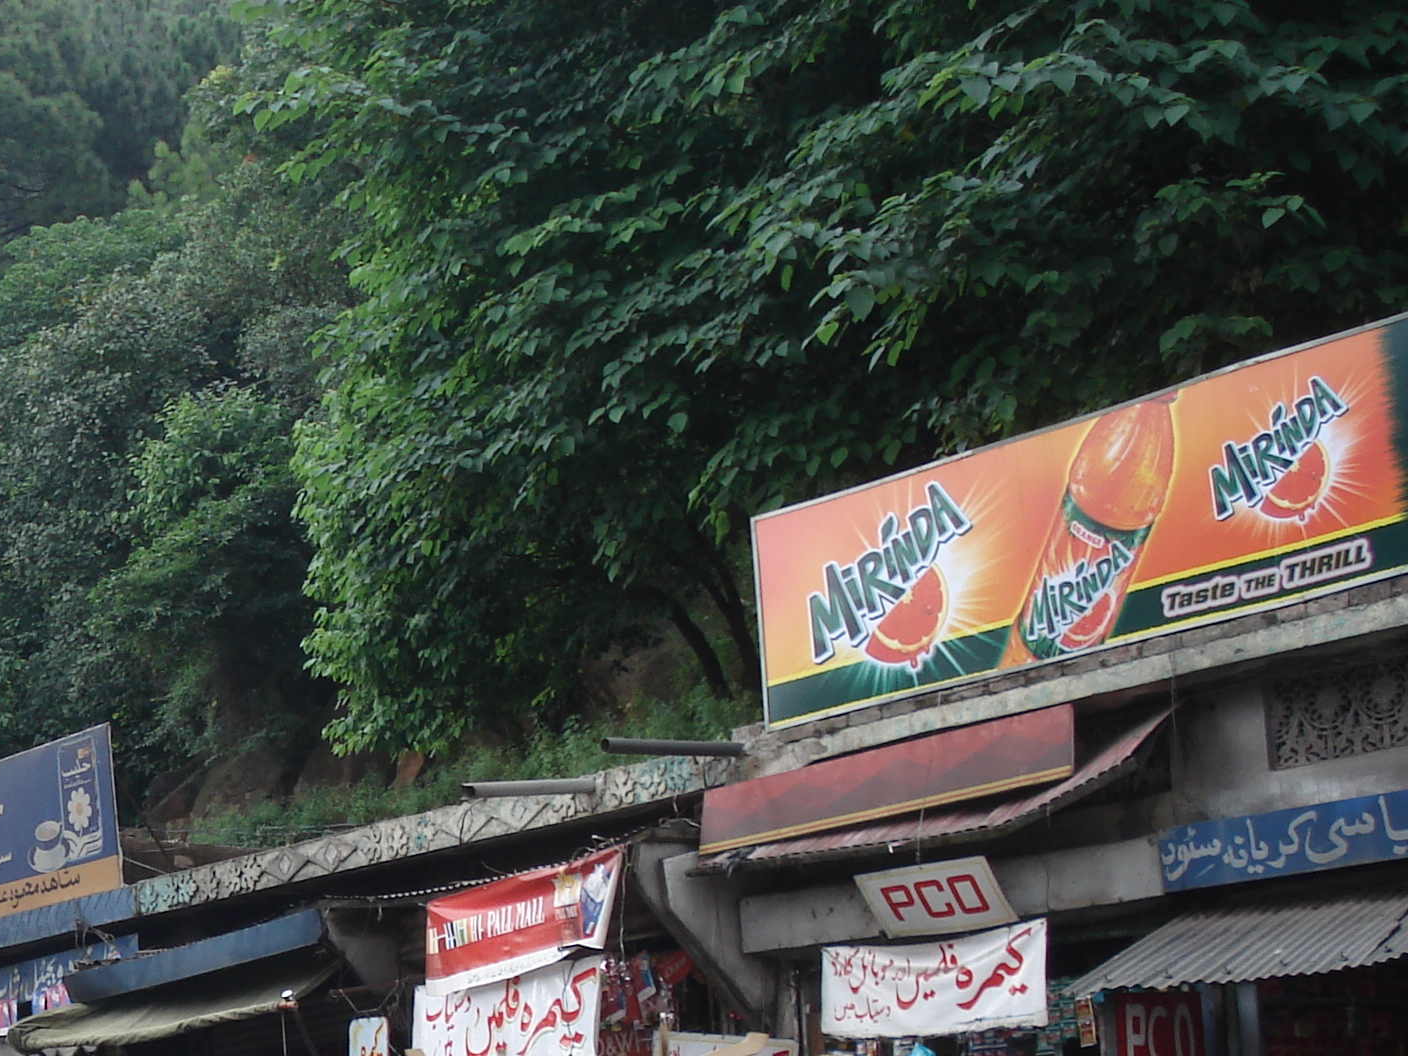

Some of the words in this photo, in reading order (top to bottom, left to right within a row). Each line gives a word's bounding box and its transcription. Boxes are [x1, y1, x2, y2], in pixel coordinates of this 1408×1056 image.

[1071, 522, 1103, 548] ORANGE
[1165, 579, 1235, 611] Taste
[1244, 573, 1275, 593] THE
[1283, 544, 1366, 583] THRILL
[487, 905, 514, 938] PALL
[516, 896, 545, 930] MALL
[880, 874, 990, 922] PCO
[896, 943, 959, 1011] فلمیں
[955, 928, 1032, 1011] کیمرہ
